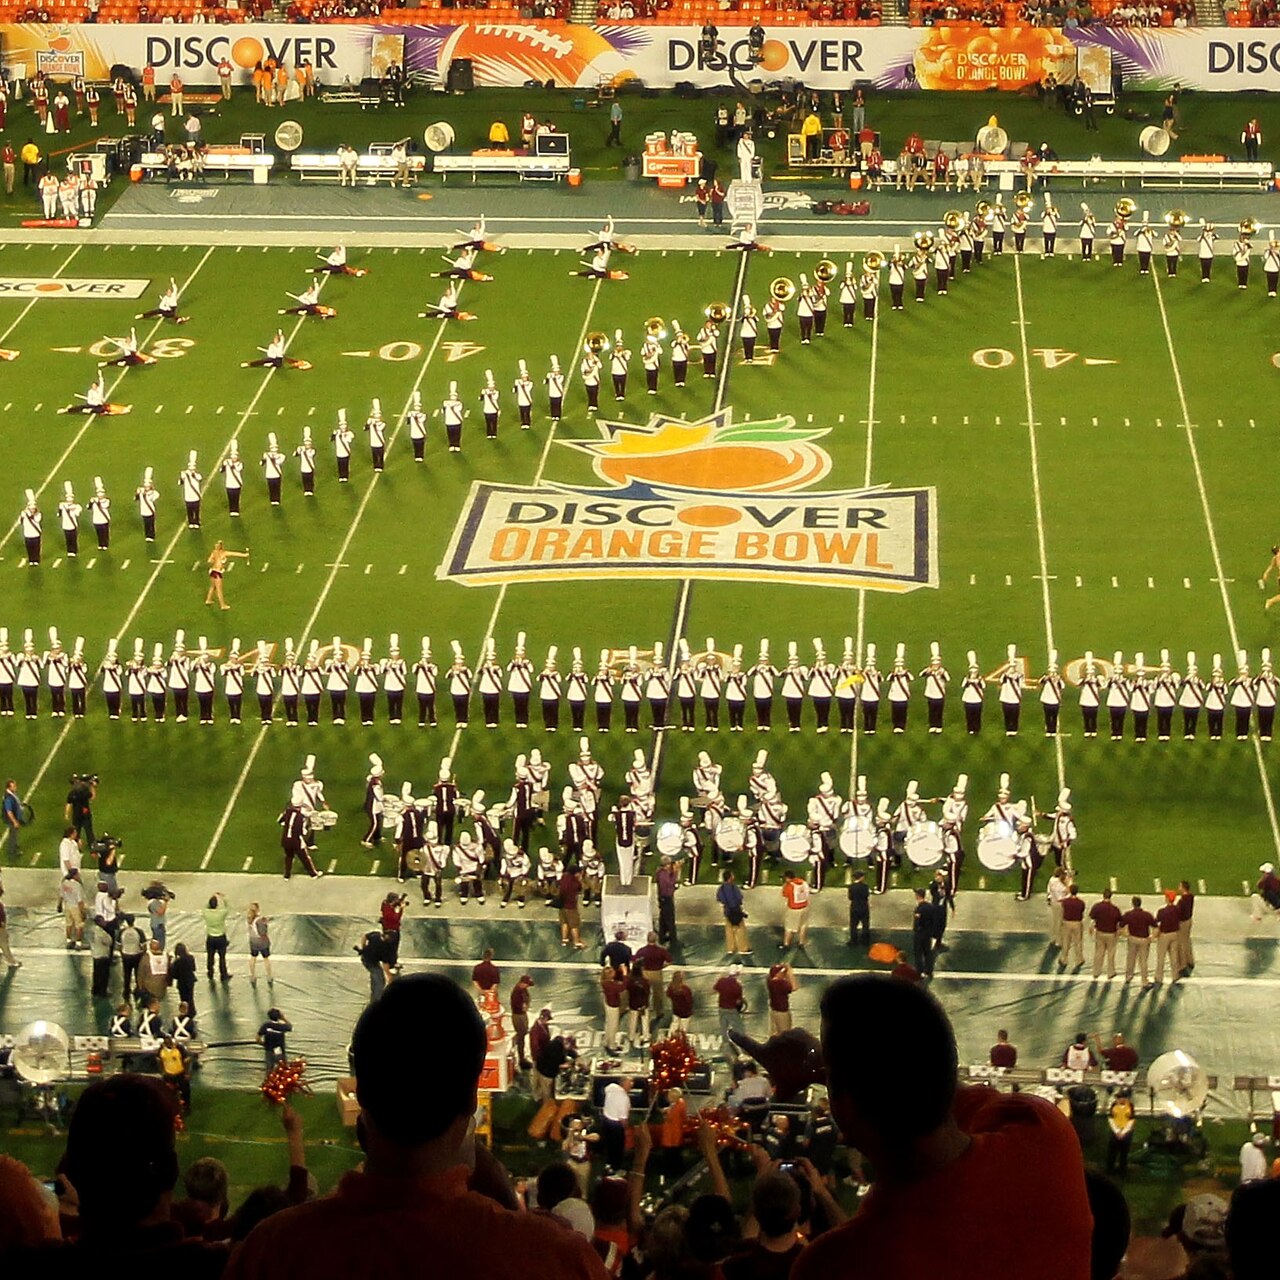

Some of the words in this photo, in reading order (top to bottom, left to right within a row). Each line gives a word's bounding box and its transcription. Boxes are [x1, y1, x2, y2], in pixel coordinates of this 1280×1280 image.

[40, 55, 80, 63] DISCOVER
[146, 36, 336, 69] DISCOVER
[669, 39, 865, 71] DISCOVER
[957, 53, 1027, 66] DISCOVER
[1000, 66, 1028, 80] BOWL
[505, 501, 891, 530] DISCOVER
[489, 527, 717, 562] ORANGE
[734, 531, 894, 570] BOWL
